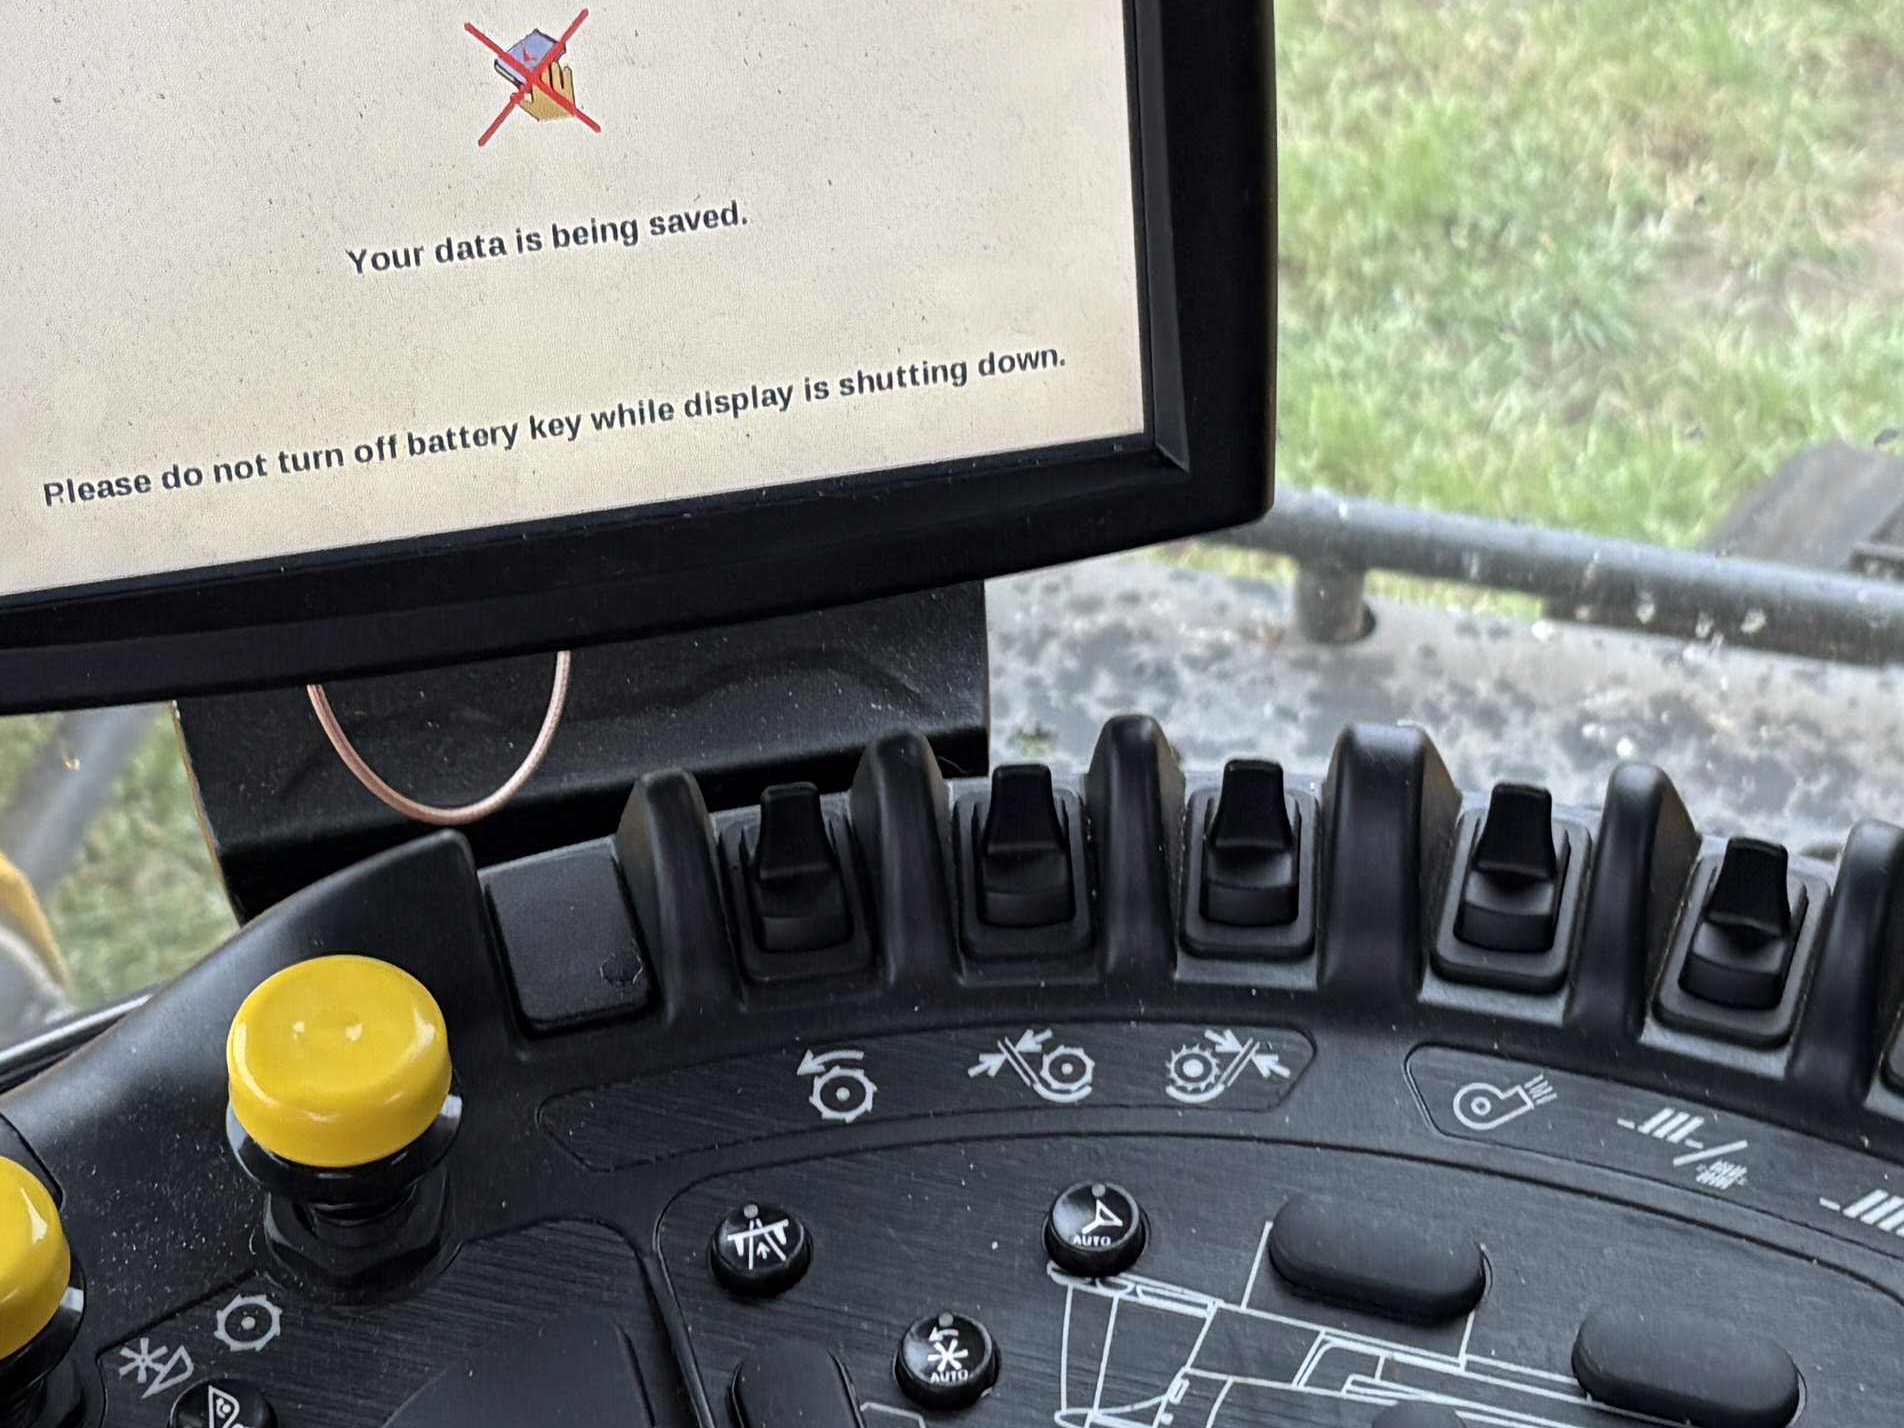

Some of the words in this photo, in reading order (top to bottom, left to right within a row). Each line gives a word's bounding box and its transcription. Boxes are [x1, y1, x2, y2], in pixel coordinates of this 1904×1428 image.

[344, 244, 426, 276] Your
[433, 233, 509, 265] data
[514, 226, 544, 255] is
[550, 216, 640, 250] being
[648, 198, 749, 237] saved.
[42, 473, 153, 508] Please
[160, 462, 204, 491] do
[212, 452, 269, 485] not
[276, 447, 346, 475] turn
[353, 432, 399, 465] off
[405, 421, 520, 458] battery
[528, 413, 583, 443] key
[589, 397, 676, 432] while
[683, 383, 795, 420] display
[803, 375, 831, 403] is
[838, 359, 969, 398] shutting
[977, 347, 1067, 378] down.
[1072, 1235, 1111, 1247] AUTO
[929, 1369, 969, 1385] AUTO
